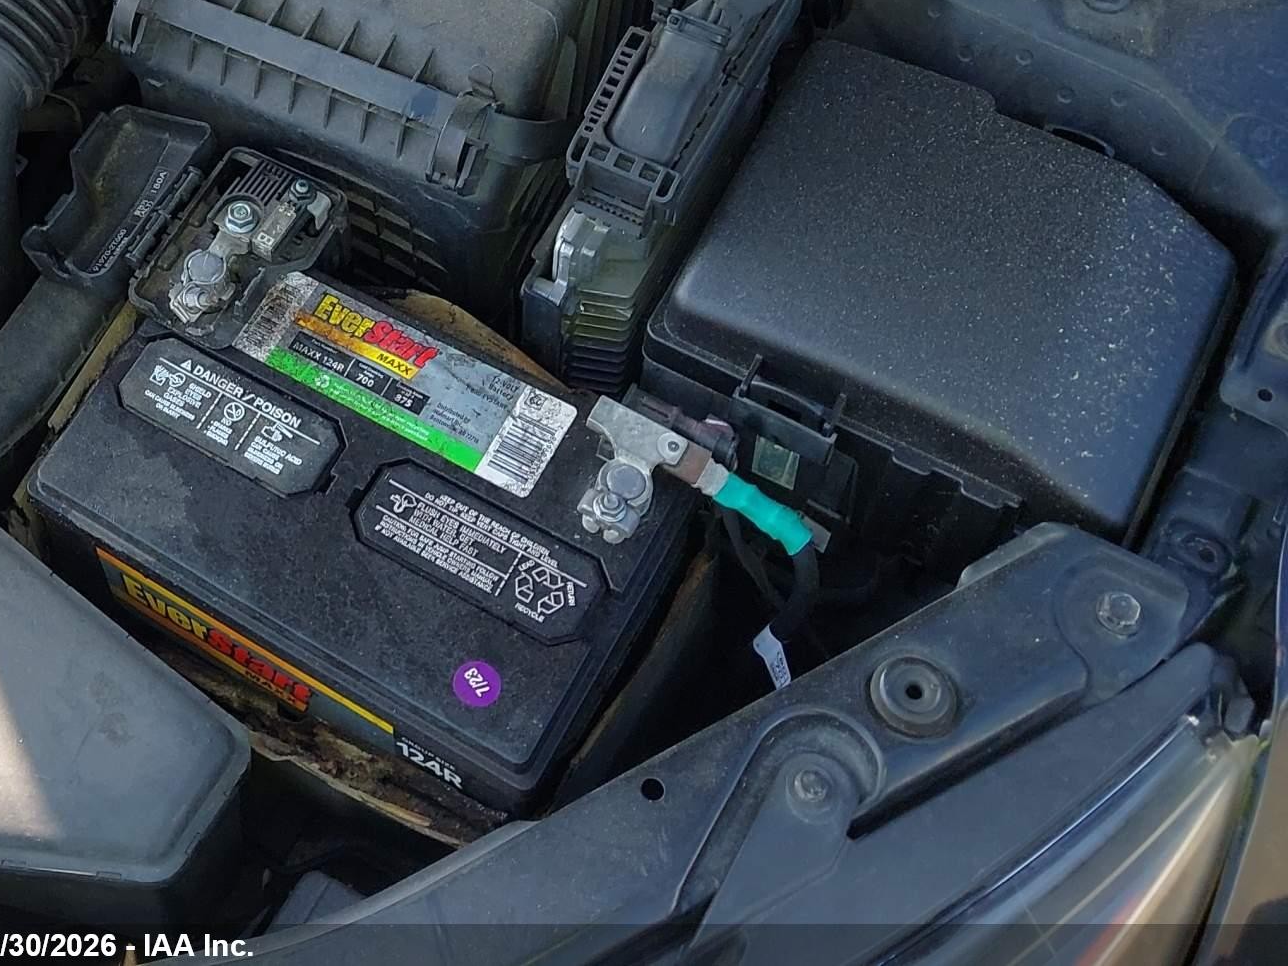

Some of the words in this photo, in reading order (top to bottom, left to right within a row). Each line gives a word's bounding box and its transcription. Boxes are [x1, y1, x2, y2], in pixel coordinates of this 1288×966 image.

[313, 292, 439, 369] EverStart
[293, 342, 322, 361] MAXX
[323, 356, 345, 372] 124R
[376, 353, 413, 376] MAXX
[355, 373, 374, 388] 700
[193, 365, 243, 398] DANGER
[253, 397, 301, 428] POISON
[394, 394, 413, 408] 875
[407, 528, 419, 539] FOR
[419, 535, 434, 546] SAFE
[409, 515, 438, 536] MEDICAL
[439, 532, 461, 546] HELP
[459, 542, 479, 557] FAST
[413, 508, 432, 523] WITH
[459, 533, 475, 545] GET
[417, 502, 441, 519] FLUSH
[440, 515, 459, 529] EYES
[459, 525, 507, 554] IMMEDIATELY
[425, 492, 435, 501] DO
[434, 498, 449, 508] NOT
[460, 510, 476, 522] KEEP
[476, 519, 492, 531] VENT
[492, 527, 509, 540] CAPS
[509, 536, 527, 550] TIGHT
[526, 546, 543, 559] AND
[540, 553, 558, 568] LEVEL
[440, 495, 456, 504] KEEP
[455, 502, 469, 513] OUT
[467, 509, 479, 519] OF
[478, 514, 491, 525] THE
[489, 521, 511, 536] REACH
[510, 532, 521, 542] OF
[519, 536, 550, 558] CHILDREN
[518, 560, 535, 571] LEAD
[567, 581, 576, 607] RETURN
[515, 602, 545, 623] RECYCLE
[121, 573, 312, 702] EverStart
[464, 667, 490, 698] 7/23
[401, 736, 434, 757] GROUP
[396, 741, 462, 789] 124R
